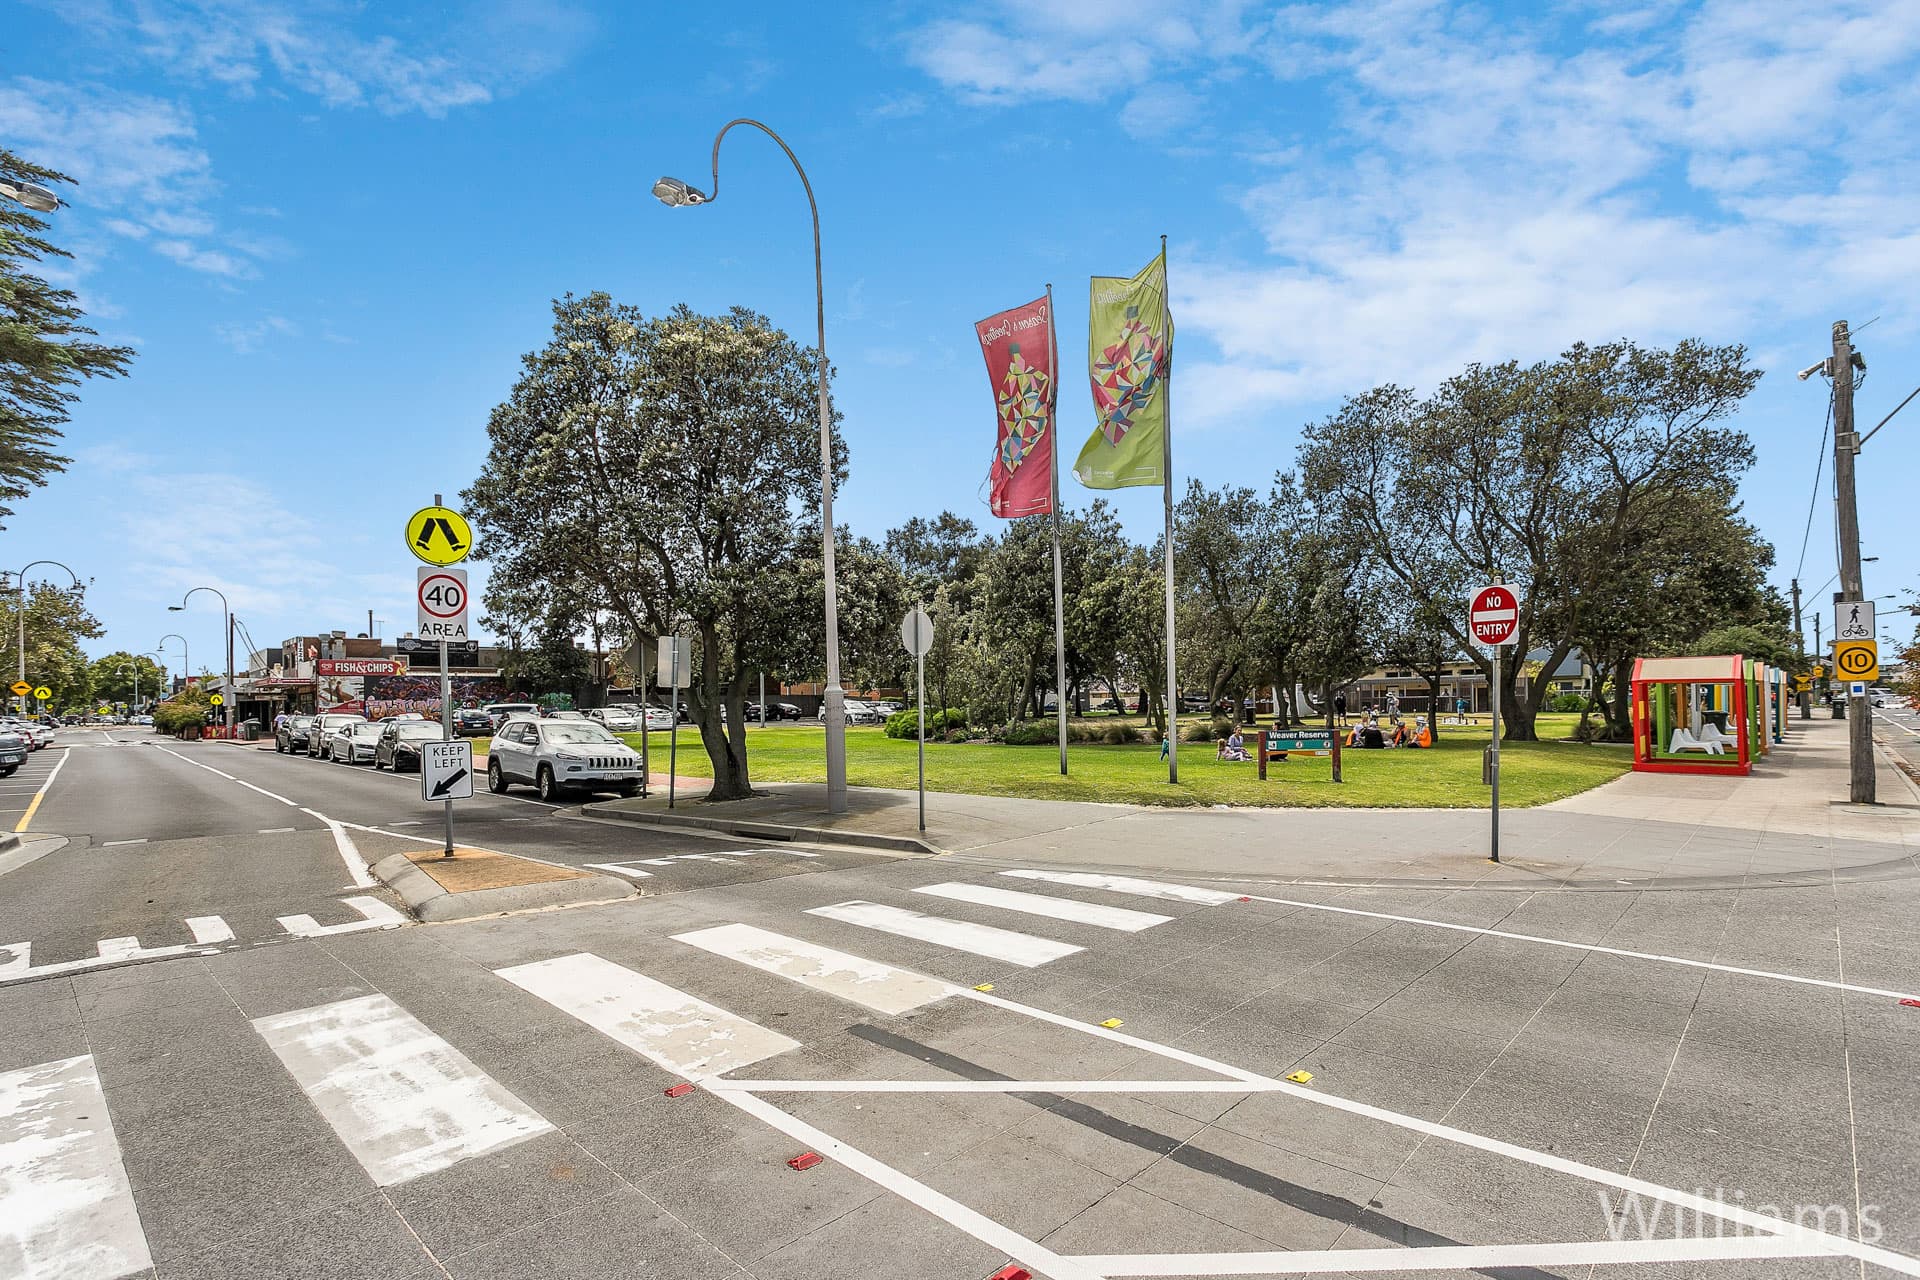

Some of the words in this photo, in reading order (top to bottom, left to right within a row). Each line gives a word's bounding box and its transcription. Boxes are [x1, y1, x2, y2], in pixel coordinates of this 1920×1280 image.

[425, 585, 460, 607] 40
[1486, 596, 1502, 608] NO
[420, 623, 466, 637] AREA
[1476, 623, 1511, 636] ENTRY
[1846, 654, 1868, 668] 10
[1269, 731, 1297, 739] Weaver
[432, 745, 465, 757] KEEP
[434, 757, 463, 769] LEFT
